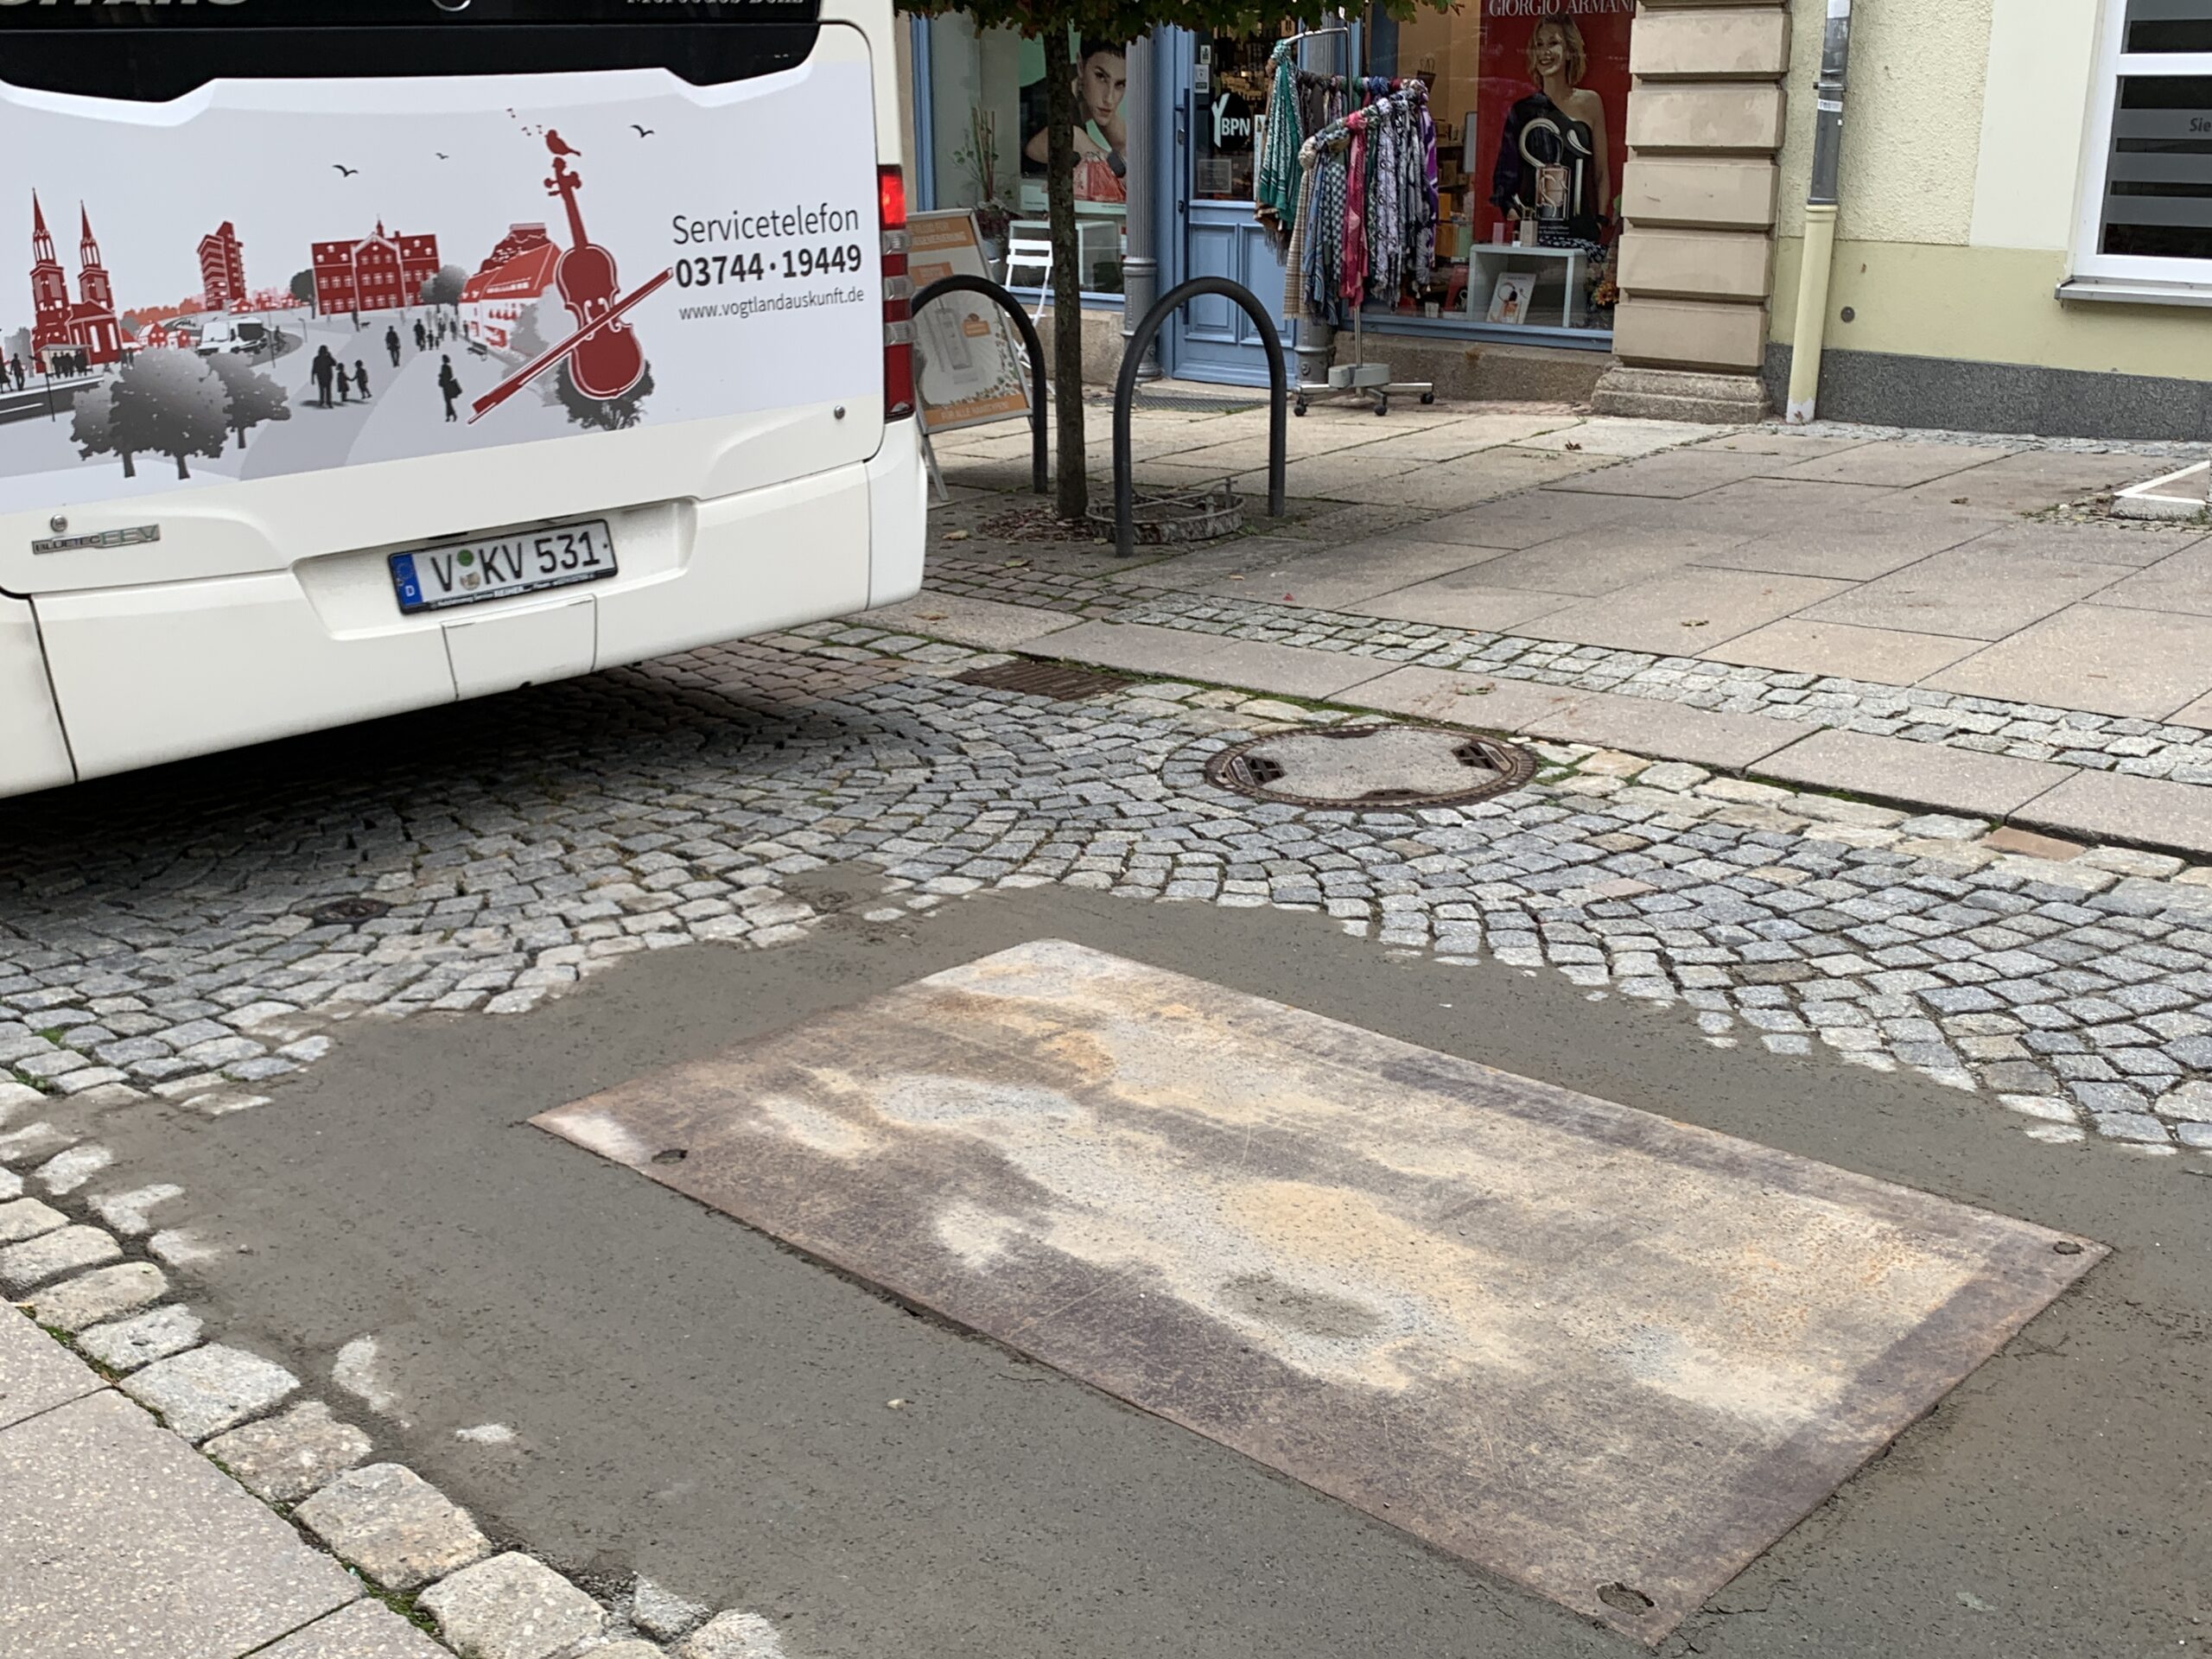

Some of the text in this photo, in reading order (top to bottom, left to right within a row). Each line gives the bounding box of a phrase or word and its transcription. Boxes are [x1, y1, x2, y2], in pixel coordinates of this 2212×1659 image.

[1489, 0, 1560, 16] GIORGIO
[672, 202, 860, 245] Servicetelefon
[679, 286, 865, 321] www.vogtlandauskunft.de
[35, 524, 158, 552] BLUETEC EEV
[430, 554, 453, 593] V
[479, 542, 523, 585] KV
[535, 531, 601, 574] 531
